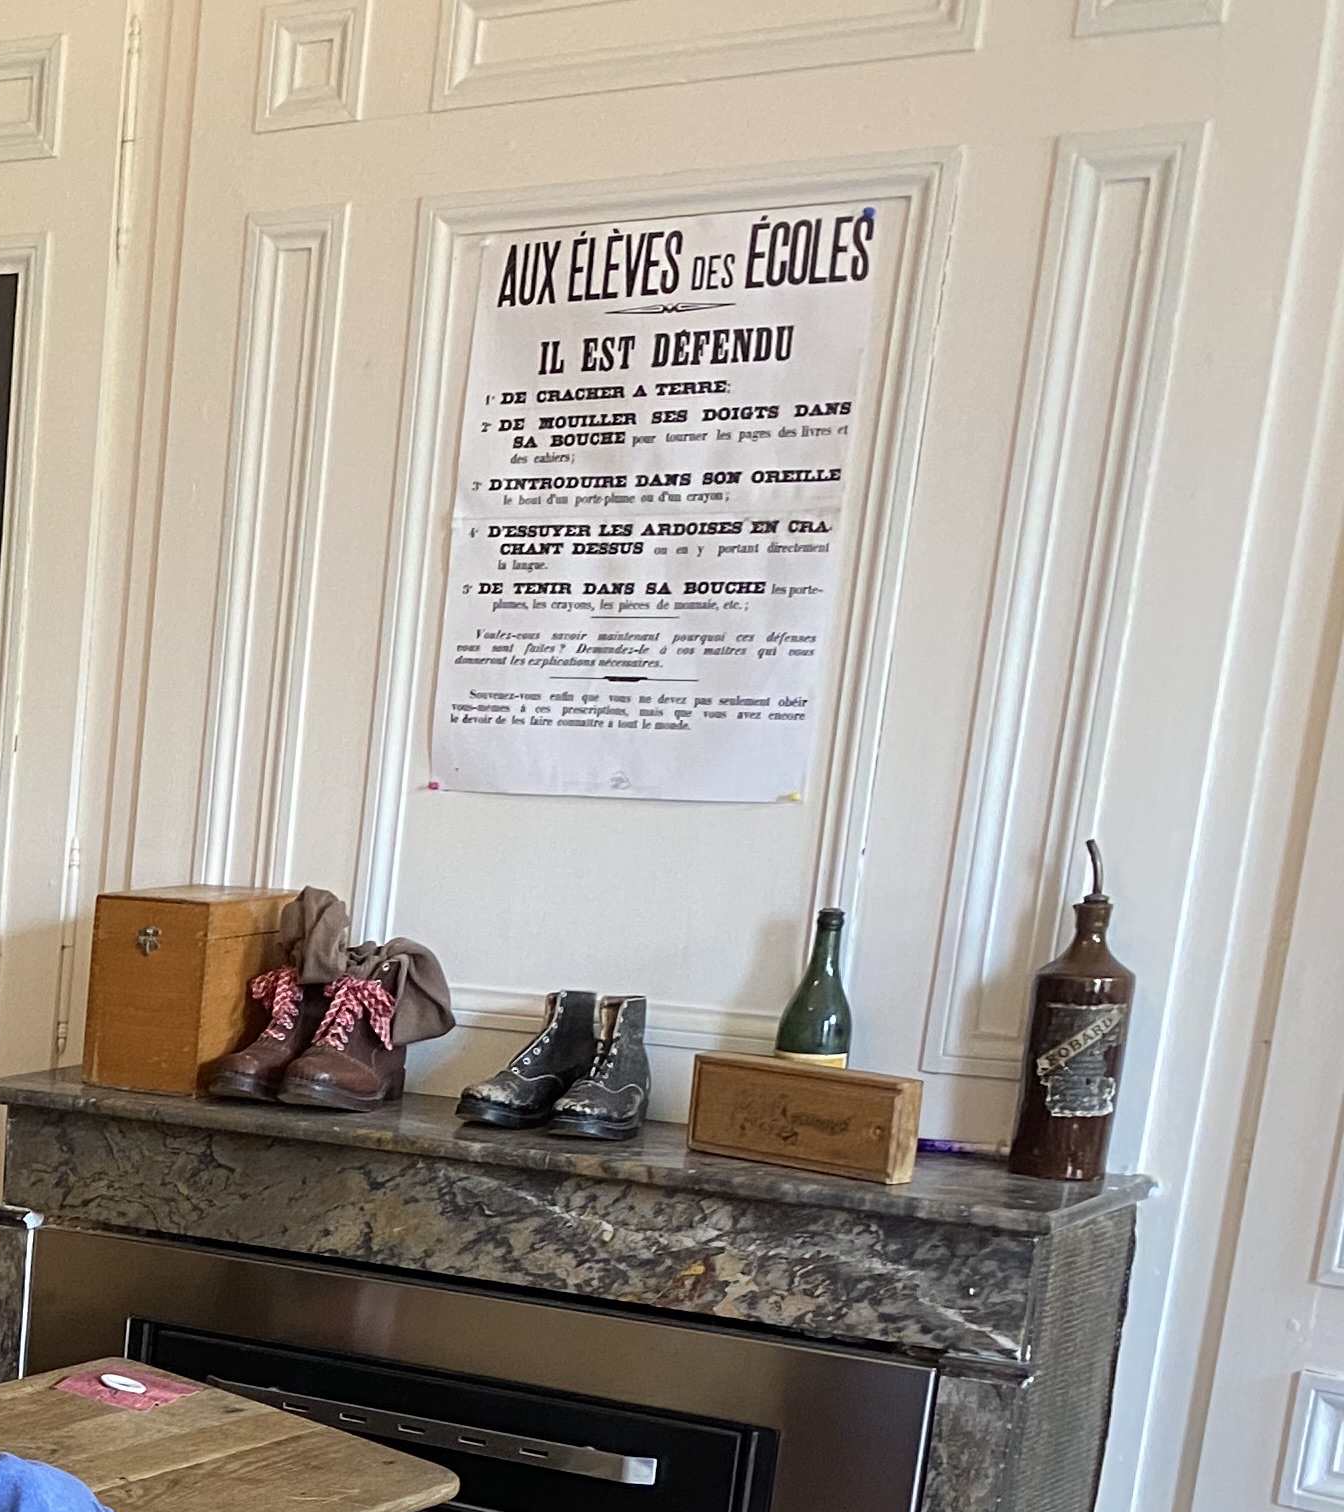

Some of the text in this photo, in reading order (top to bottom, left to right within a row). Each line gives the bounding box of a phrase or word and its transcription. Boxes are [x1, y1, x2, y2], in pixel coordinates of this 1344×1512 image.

[497, 215, 874, 307] AUX ÉLÈVES DES ÉCOLES
[538, 325, 794, 375] IL EST DÉFENDU
[500, 392, 527, 404] DE
[536, 386, 625, 403] CRACHER
[633, 385, 647, 398] A
[498, 418, 525, 431] DE
[538, 413, 637, 430] MOUILLER
[651, 410, 688, 424] SES
[702, 405, 780, 421] DOIGTS
[794, 401, 852, 418] DANS
[512, 425, 848, 449] SA BOUCHE pour tourner les pages des livres et
[510, 452, 527, 464] des
[635, 473, 691, 487] DANS
[702, 471, 742, 486] SON
[751, 469, 841, 484] OREILLE
[503, 495, 513, 505] le
[518, 494, 541, 505] bout
[641, 495, 654, 504] ou
[598, 523, 633, 537] LES
[640, 521, 743, 536] ARDOISES
[750, 520, 780, 534] EN
[500, 542, 564, 555] CHANT
[572, 541, 644, 555] DESSUS
[655, 546, 667, 555] ou
[675, 546, 689, 555] en
[717, 543, 759, 557] portant
[767, 542, 830, 553] directement
[498, 559, 507, 570] la
[478, 582, 504, 595] DE
[513, 582, 572, 595] TENIR
[582, 582, 635, 595] DANS
[645, 582, 672, 595] SA
[683, 580, 767, 595] BOUCHE
[771, 583, 787, 595] les
[532, 598, 547, 609] les
[599, 598, 613, 610] les
[656, 599, 669, 610] de
[551, 630, 587, 641] savoir
[671, 632, 727, 645] pourquoi
[736, 633, 755, 642] ces
[766, 632, 817, 645] défenses
